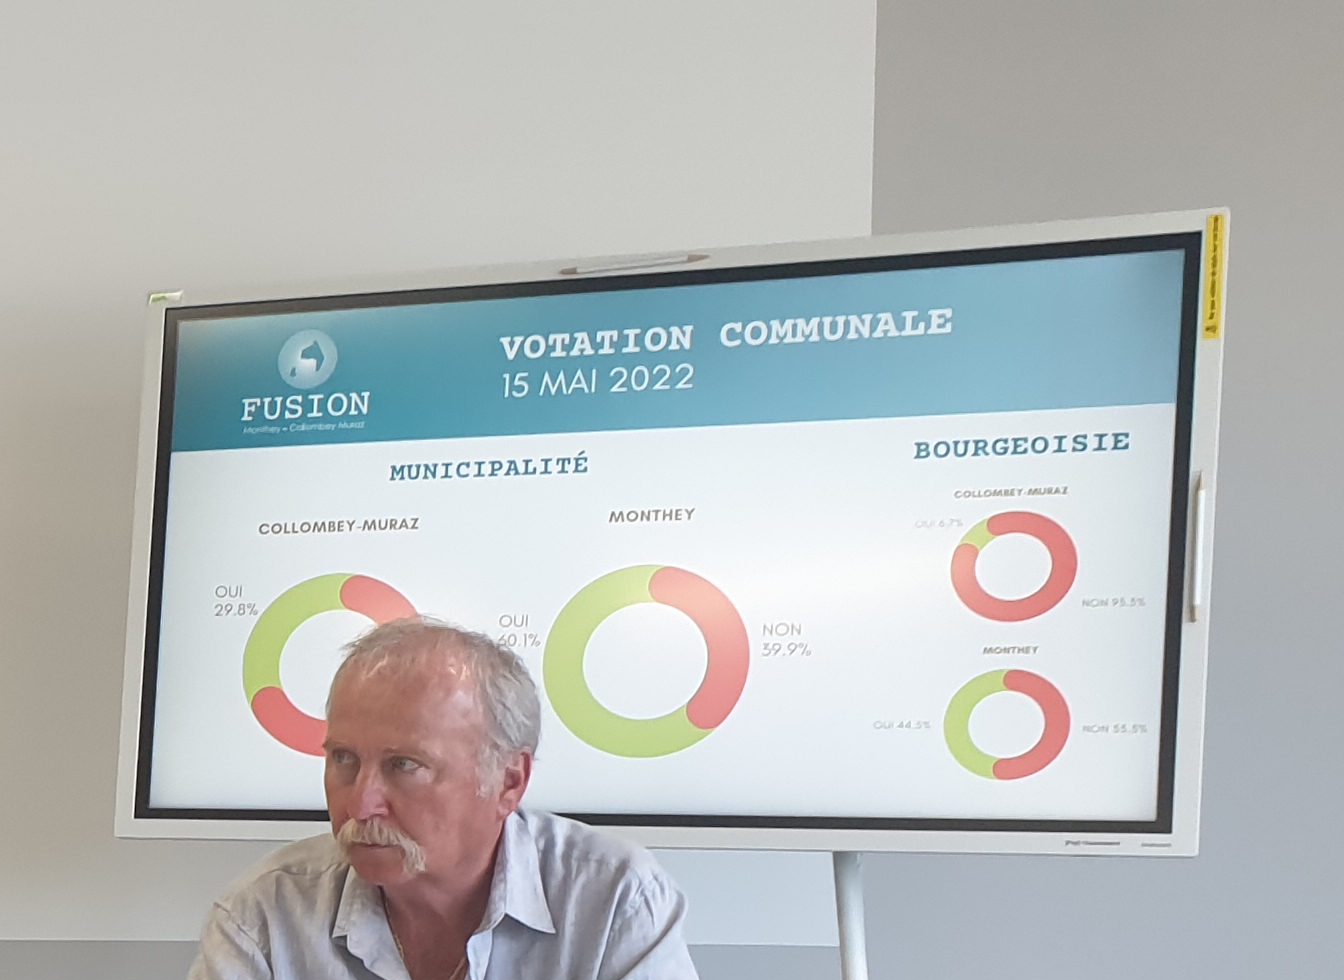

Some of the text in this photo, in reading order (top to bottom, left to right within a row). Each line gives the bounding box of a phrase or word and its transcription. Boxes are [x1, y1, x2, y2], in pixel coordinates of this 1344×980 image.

[499, 308, 953, 361] VOTATION COMMUNALE
[502, 364, 695, 399] 15 MAI 2022
[240, 391, 371, 421] FUSION
[913, 432, 1130, 460] BOURGEOISIE
[389, 450, 589, 482] MUNICIPALITÉ
[954, 486, 1069, 499] COLLOMBEY-MURAZ
[608, 507, 696, 524] MONTHEY
[258, 517, 420, 535] COLLOMBEY-MURAZ
[215, 585, 243, 599] OUI
[214, 603, 259, 617] 29.8%
[1082, 598, 1109, 607] NON
[499, 614, 529, 628] OUI
[762, 623, 802, 637] NON
[762, 642, 811, 657] 39.9%
[982, 645, 1039, 655] MONTHEY
